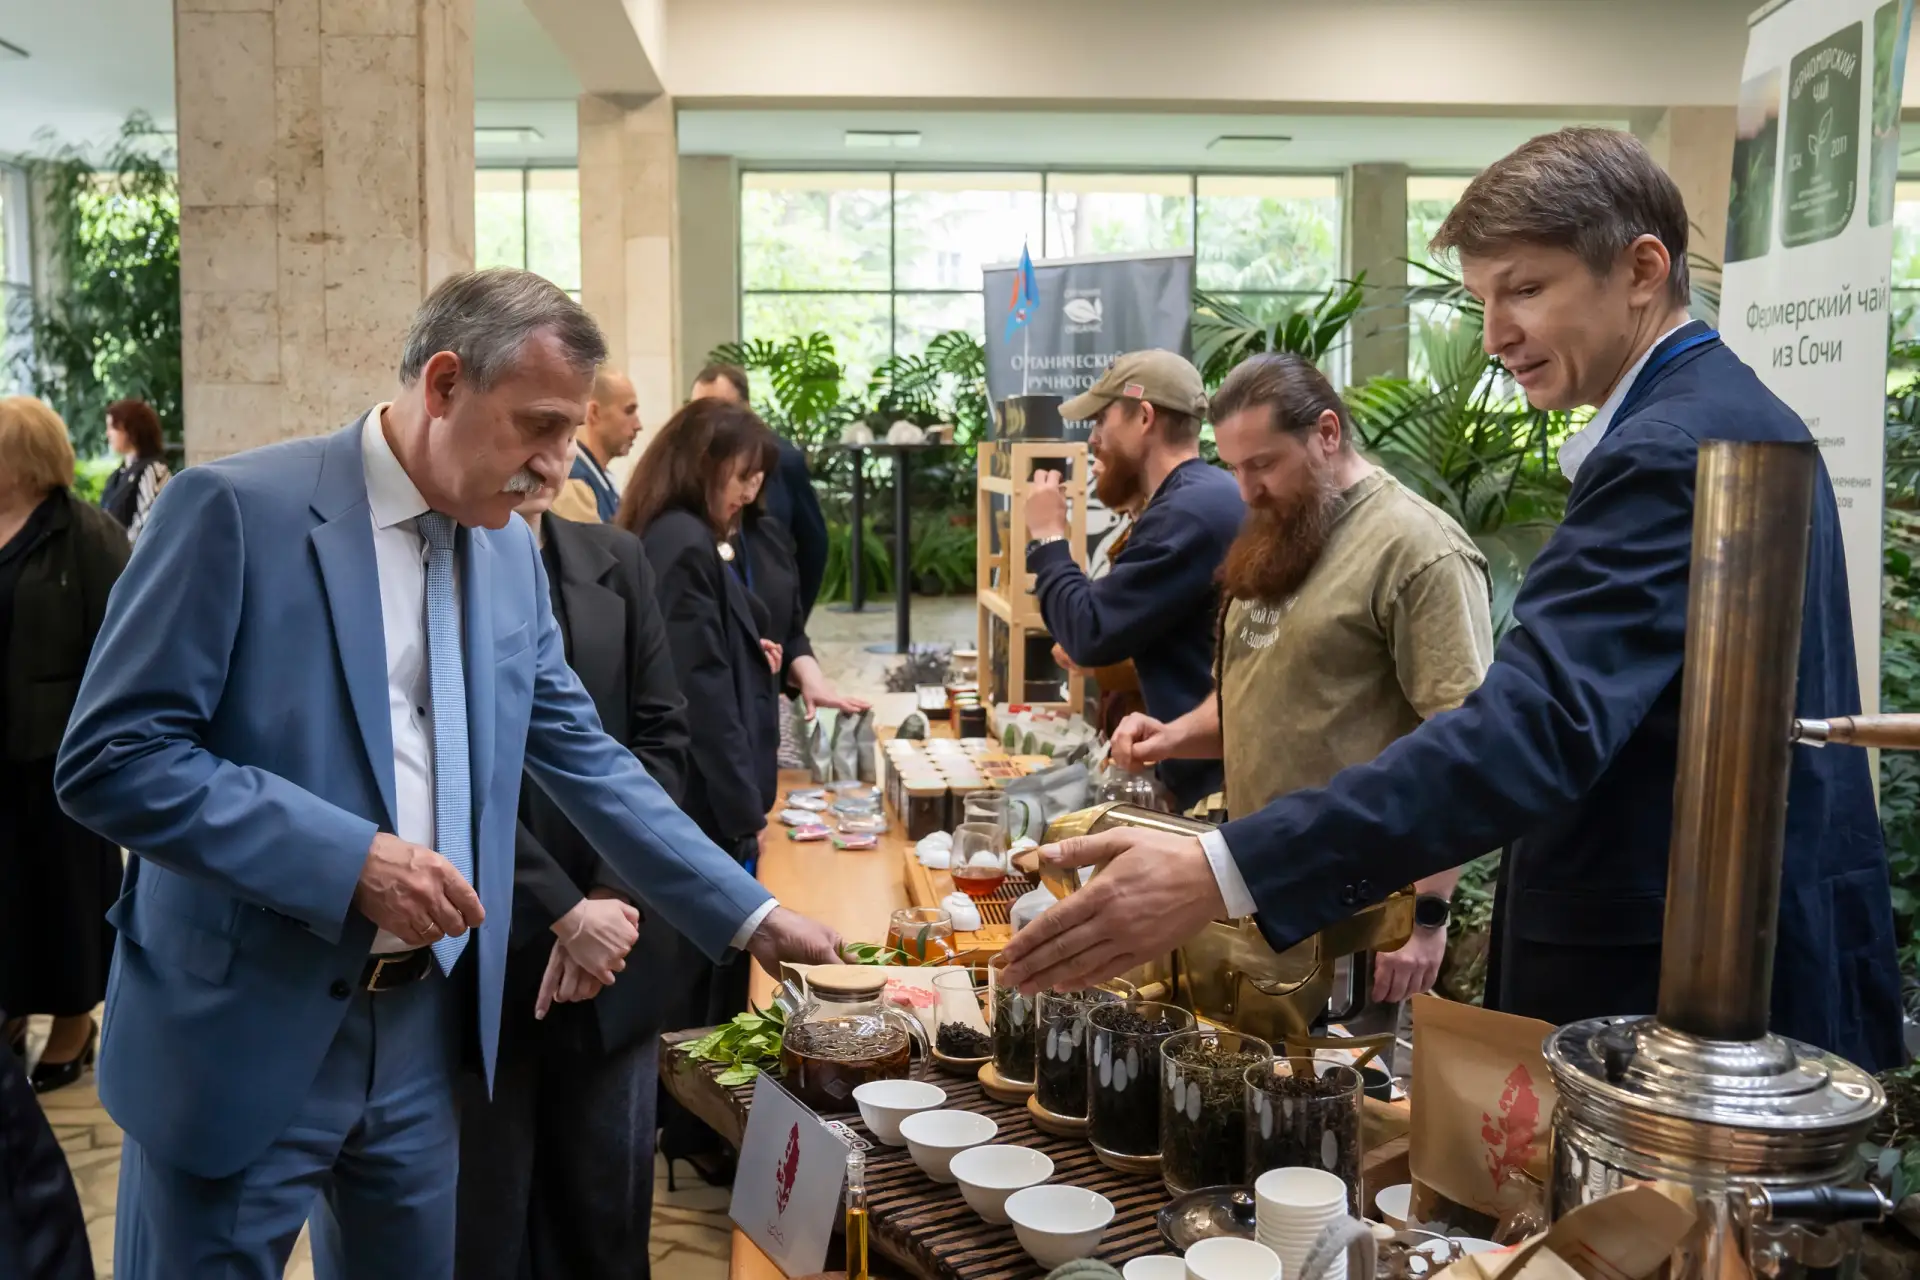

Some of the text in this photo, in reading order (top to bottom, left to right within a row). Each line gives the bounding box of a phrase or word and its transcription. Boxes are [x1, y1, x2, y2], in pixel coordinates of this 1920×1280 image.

[1813, 74, 1829, 103] ЧАЙ
[1830, 135, 1847, 159] 2011
[1746, 276, 1886, 335] Фермерский чай
[1772, 335, 1842, 368] из Сочи
